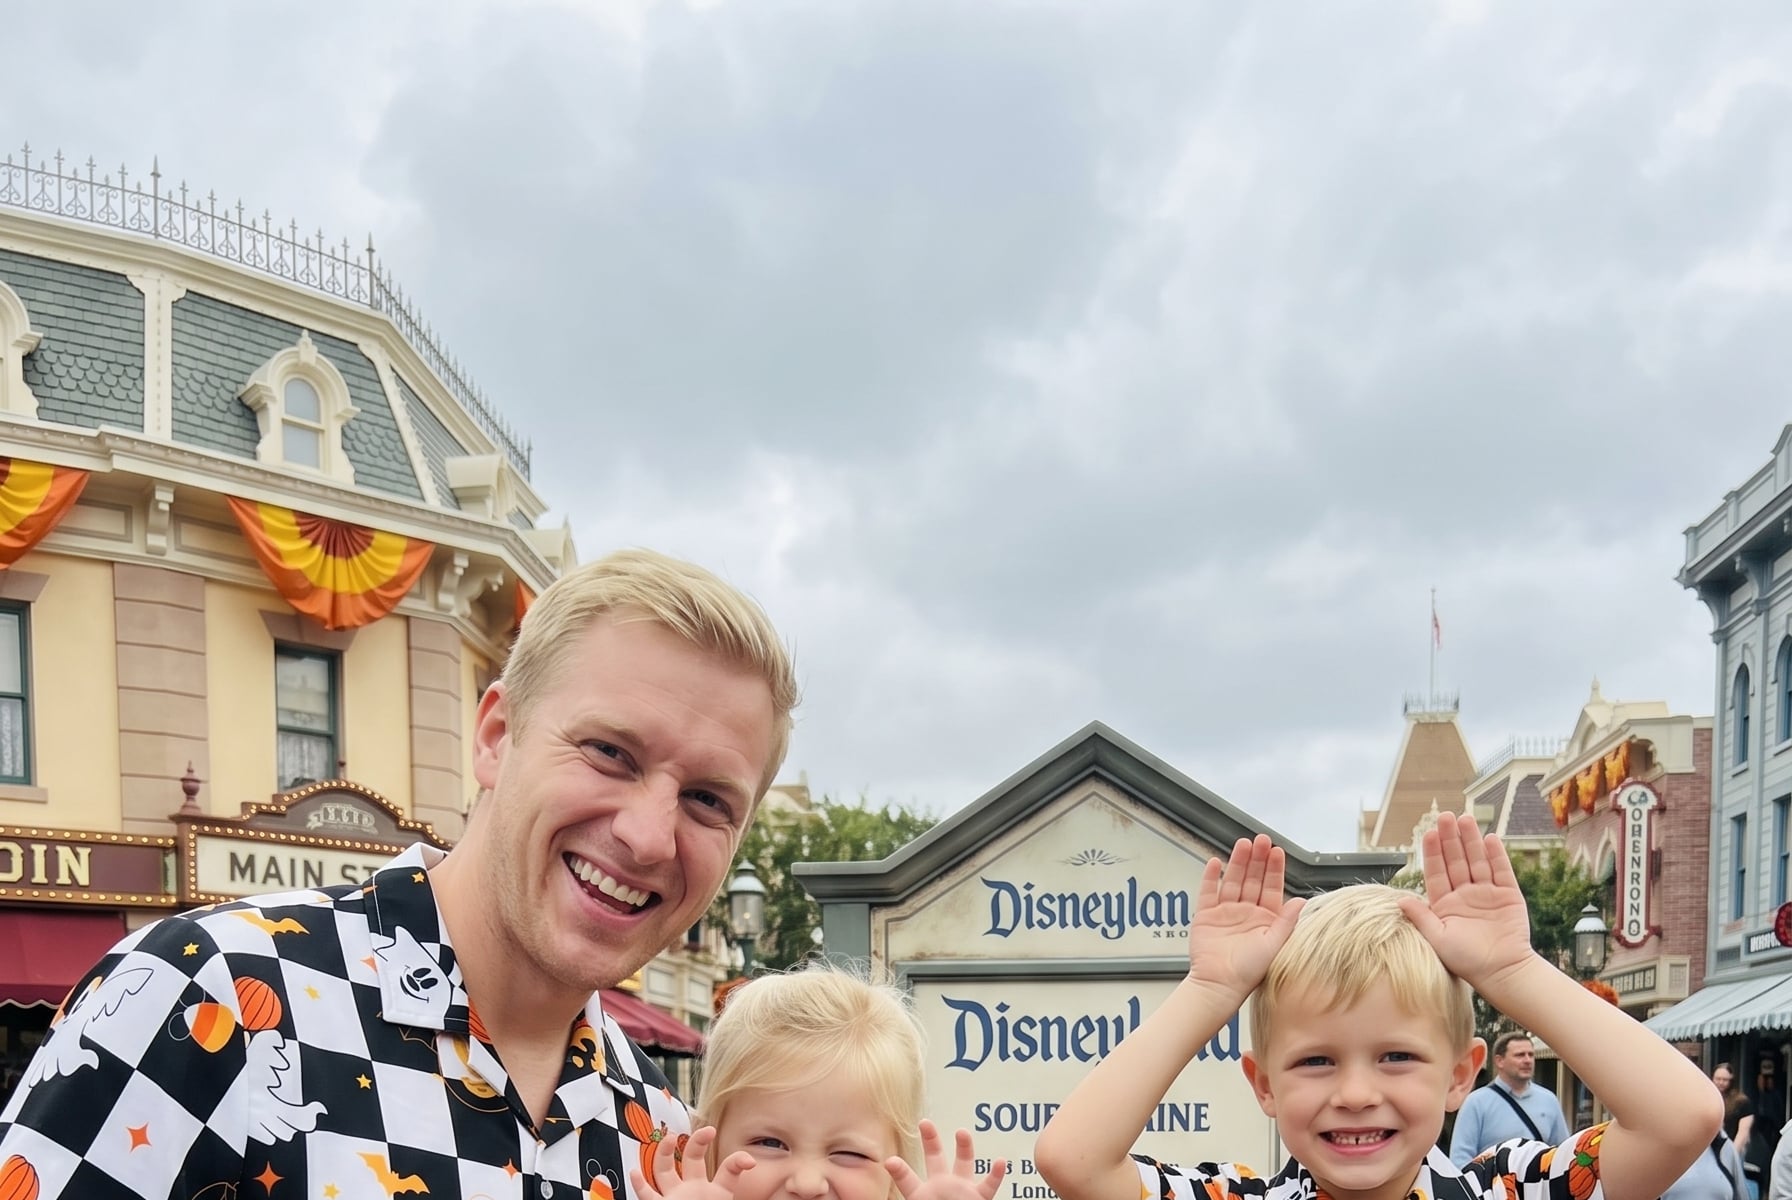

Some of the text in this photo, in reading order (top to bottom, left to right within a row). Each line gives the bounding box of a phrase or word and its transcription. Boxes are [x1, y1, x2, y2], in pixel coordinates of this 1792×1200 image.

[229, 851, 323, 888] MAIN
[980, 876, 1194, 940] Disneylan
[941, 994, 1242, 1072] Disneyld
